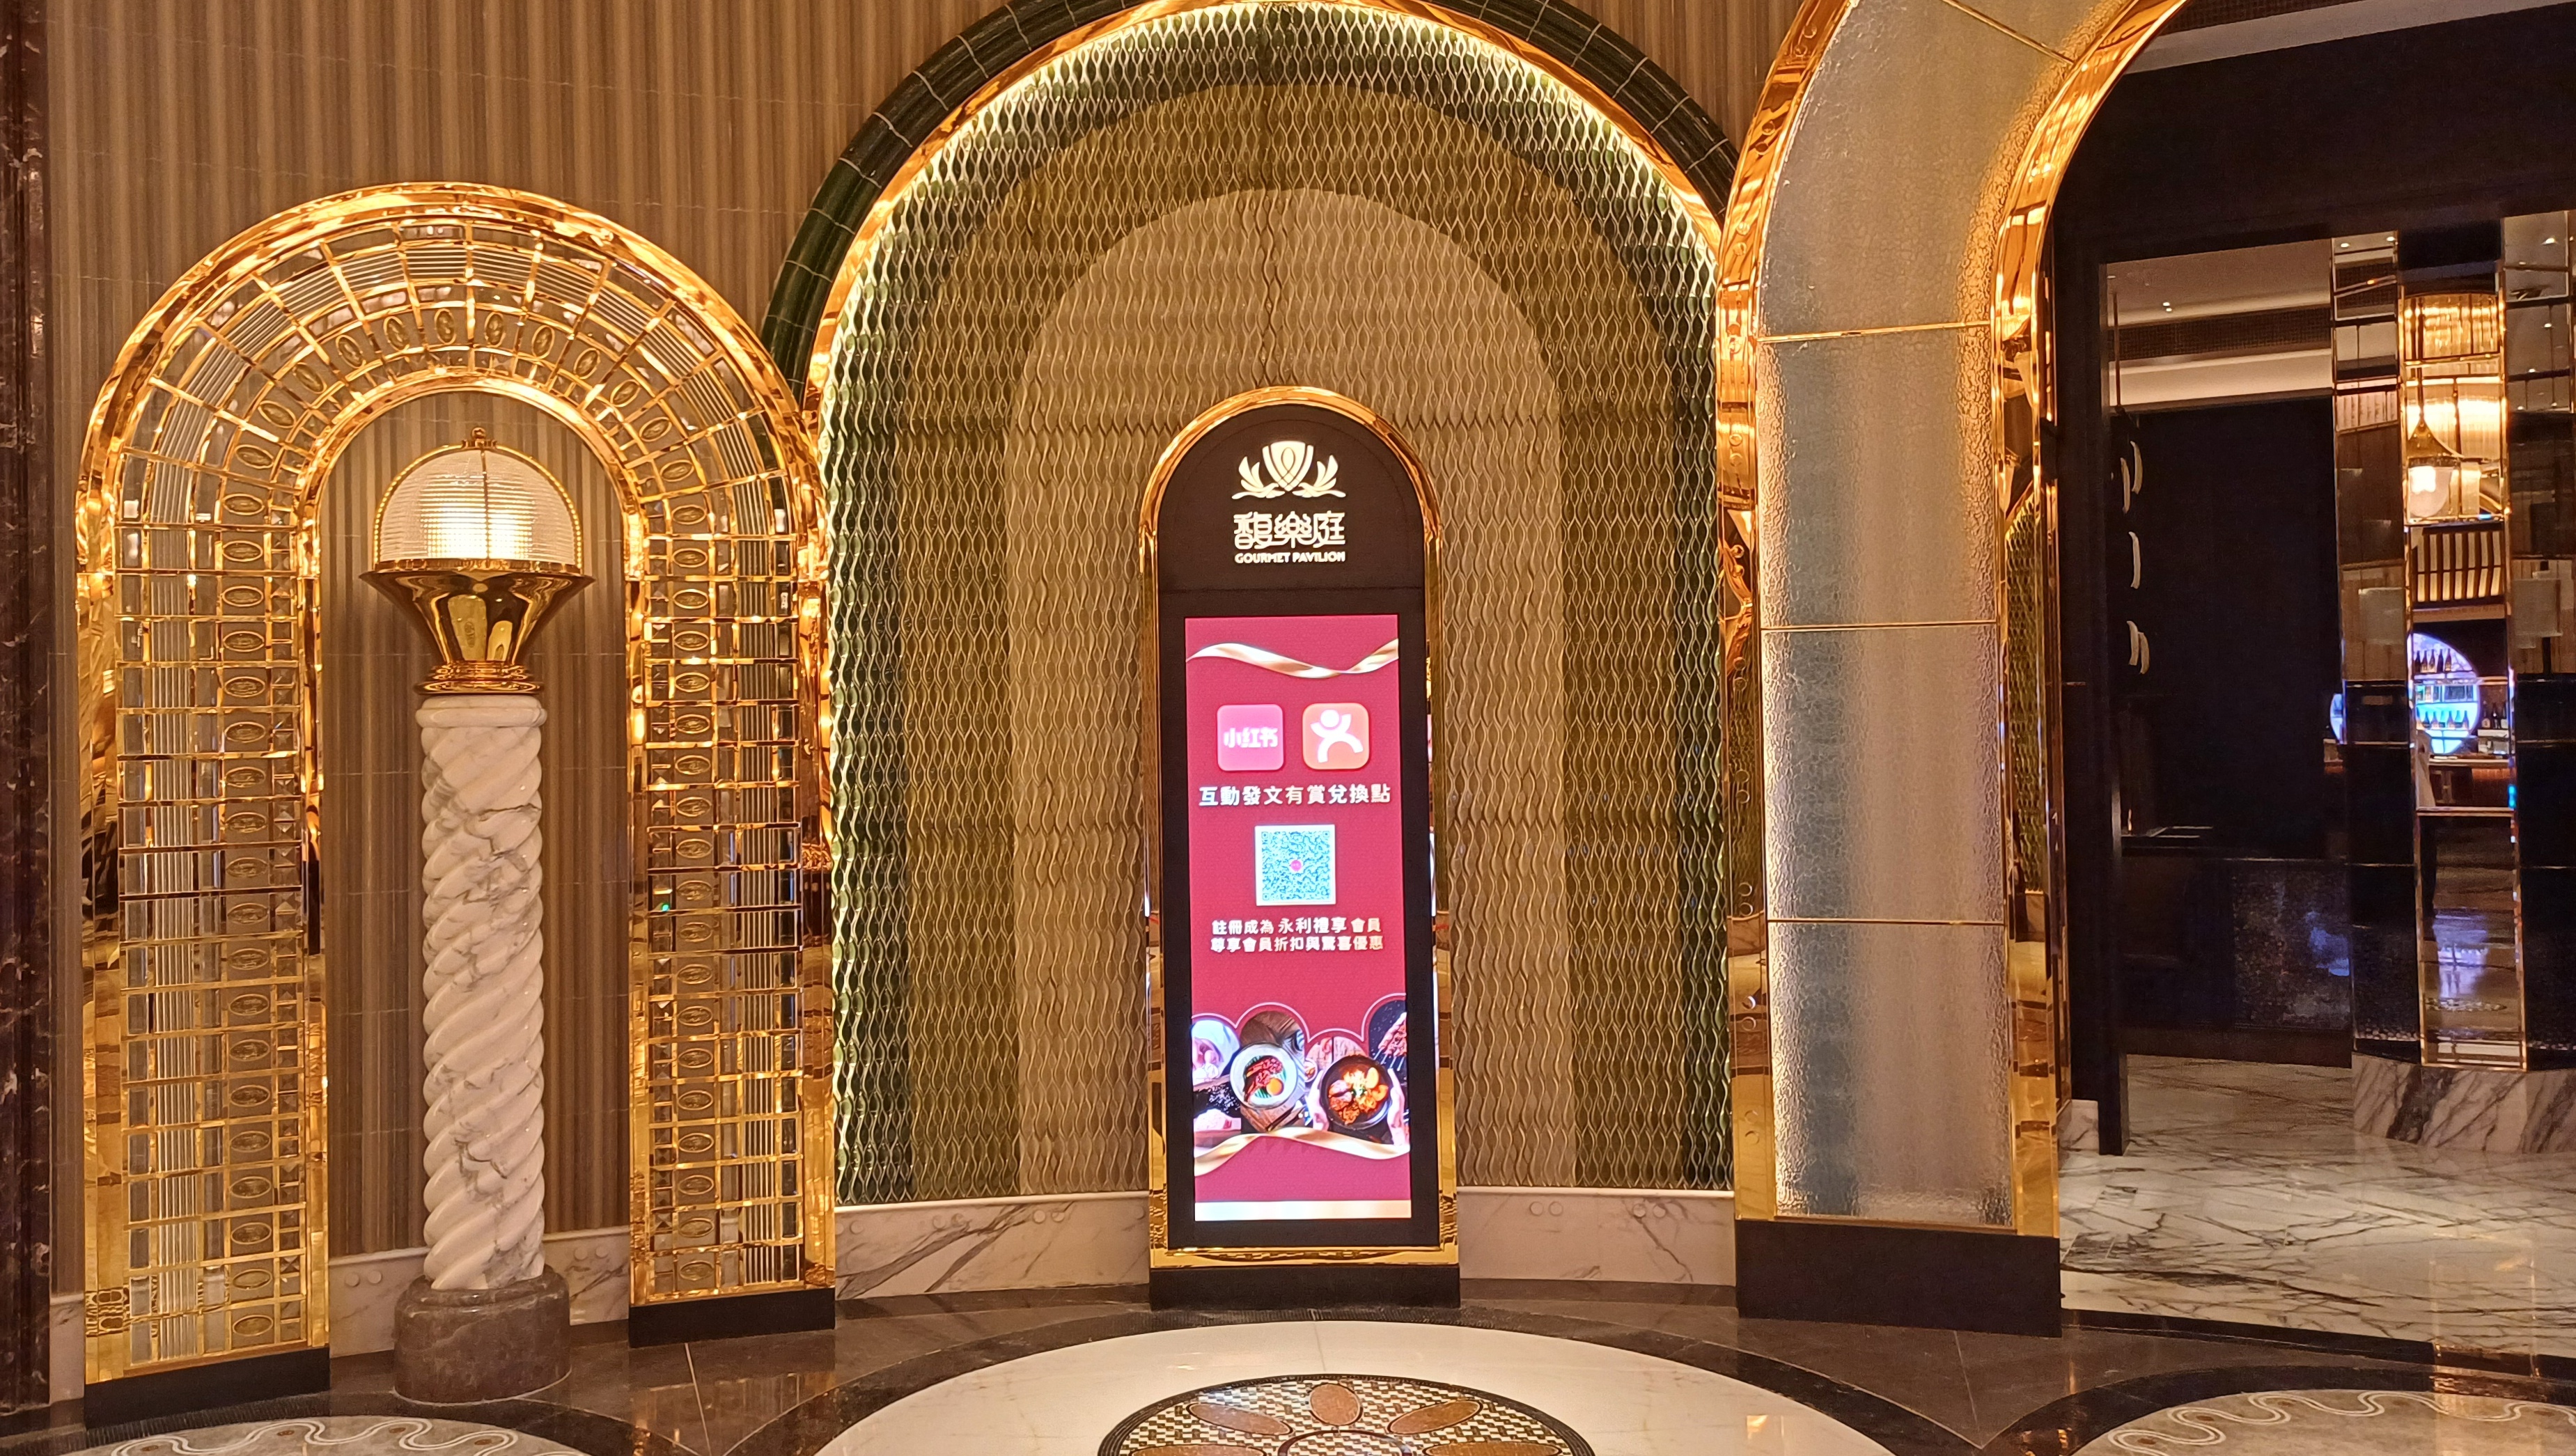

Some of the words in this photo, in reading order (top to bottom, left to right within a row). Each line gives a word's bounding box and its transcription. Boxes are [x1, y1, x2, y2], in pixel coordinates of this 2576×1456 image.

[1233, 510, 1345, 549] 馥樂庭
[1235, 552, 1290, 564] GOURMET
[1293, 551, 1345, 563] PAVILION
[1224, 727, 1278, 748] 小红书
[1199, 783, 1391, 806] 互動發文有賞兌換點
[1212, 919, 1274, 935] 註冊成為
[1278, 917, 1347, 934] 永利禮享
[1350, 917, 1382, 933] 會員
[1210, 935, 1383, 953] 尊享會員折扣與驚喜優惠
